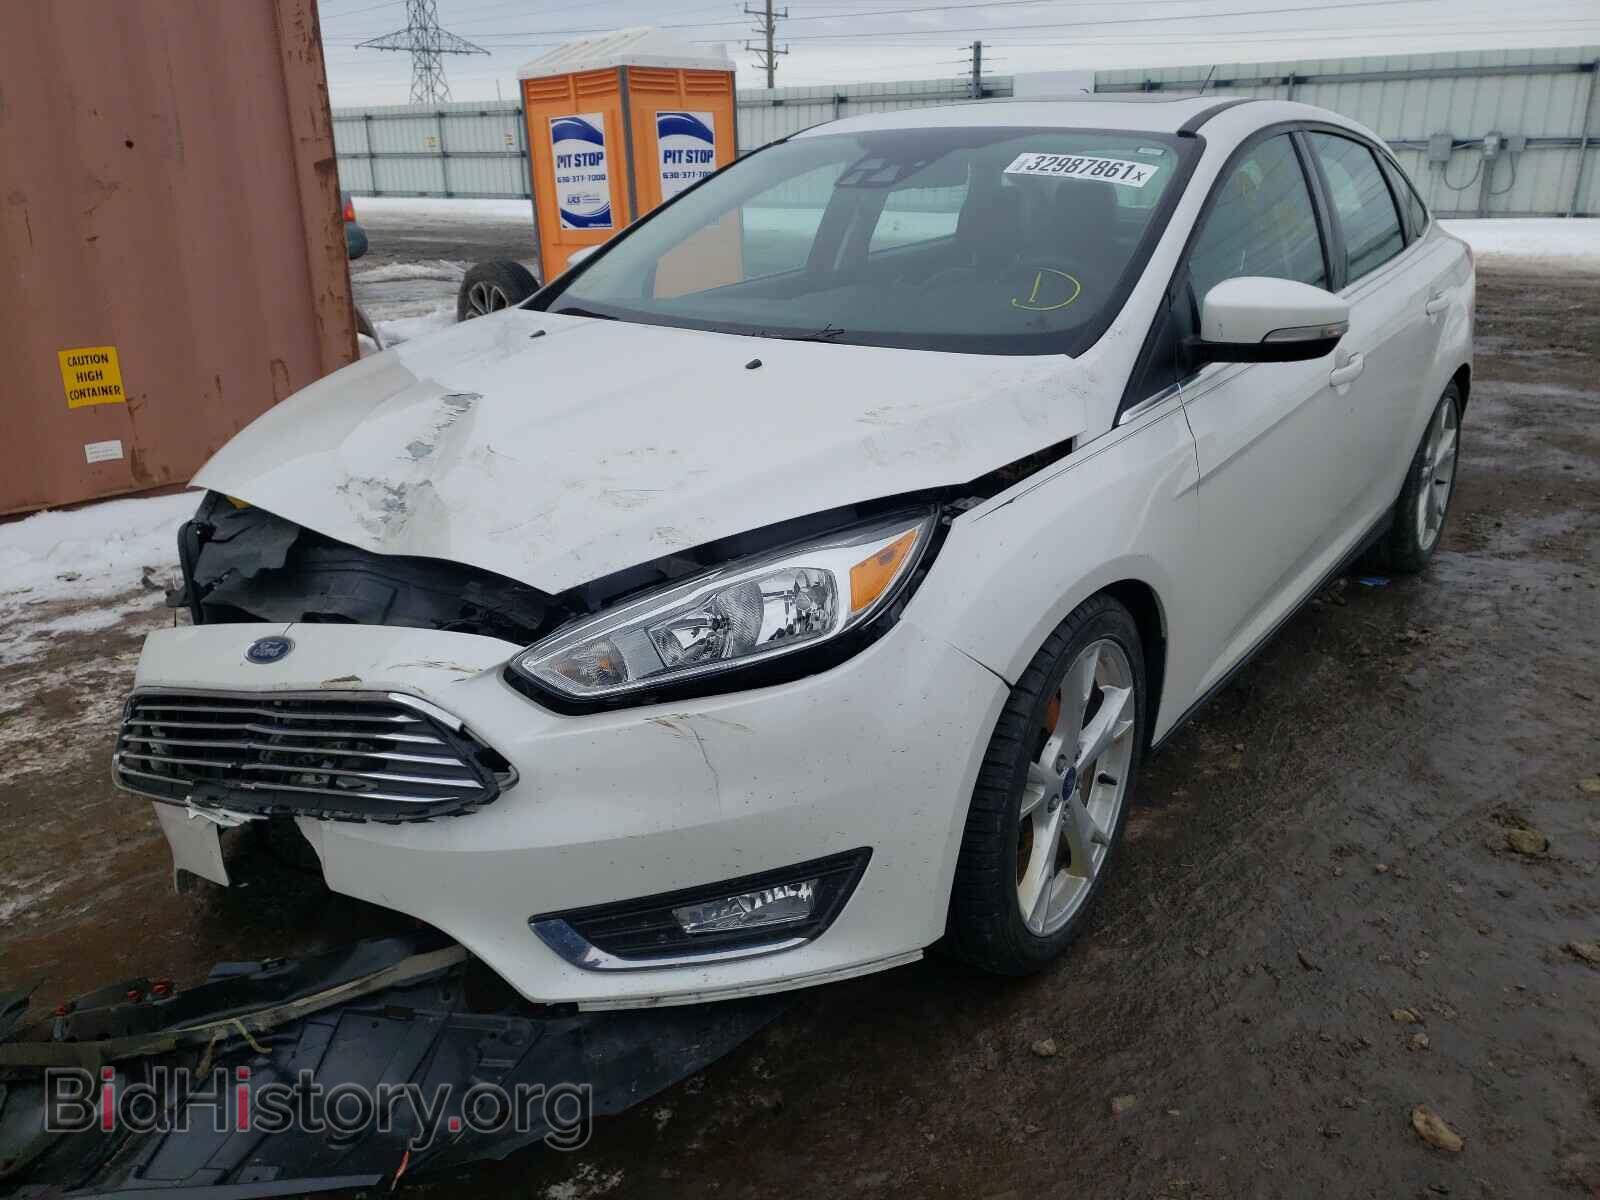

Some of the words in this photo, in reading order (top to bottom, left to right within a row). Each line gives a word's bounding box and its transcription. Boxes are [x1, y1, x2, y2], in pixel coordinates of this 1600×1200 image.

[557, 154, 573, 169] PIT
[574, 152, 604, 167] STOP
[663, 149, 684, 164] PIT
[685, 149, 714, 164] STOP
[67, 353, 109, 368] CAUTION
[75, 369, 103, 383] HIGH
[69, 384, 121, 401] CONTAINER
